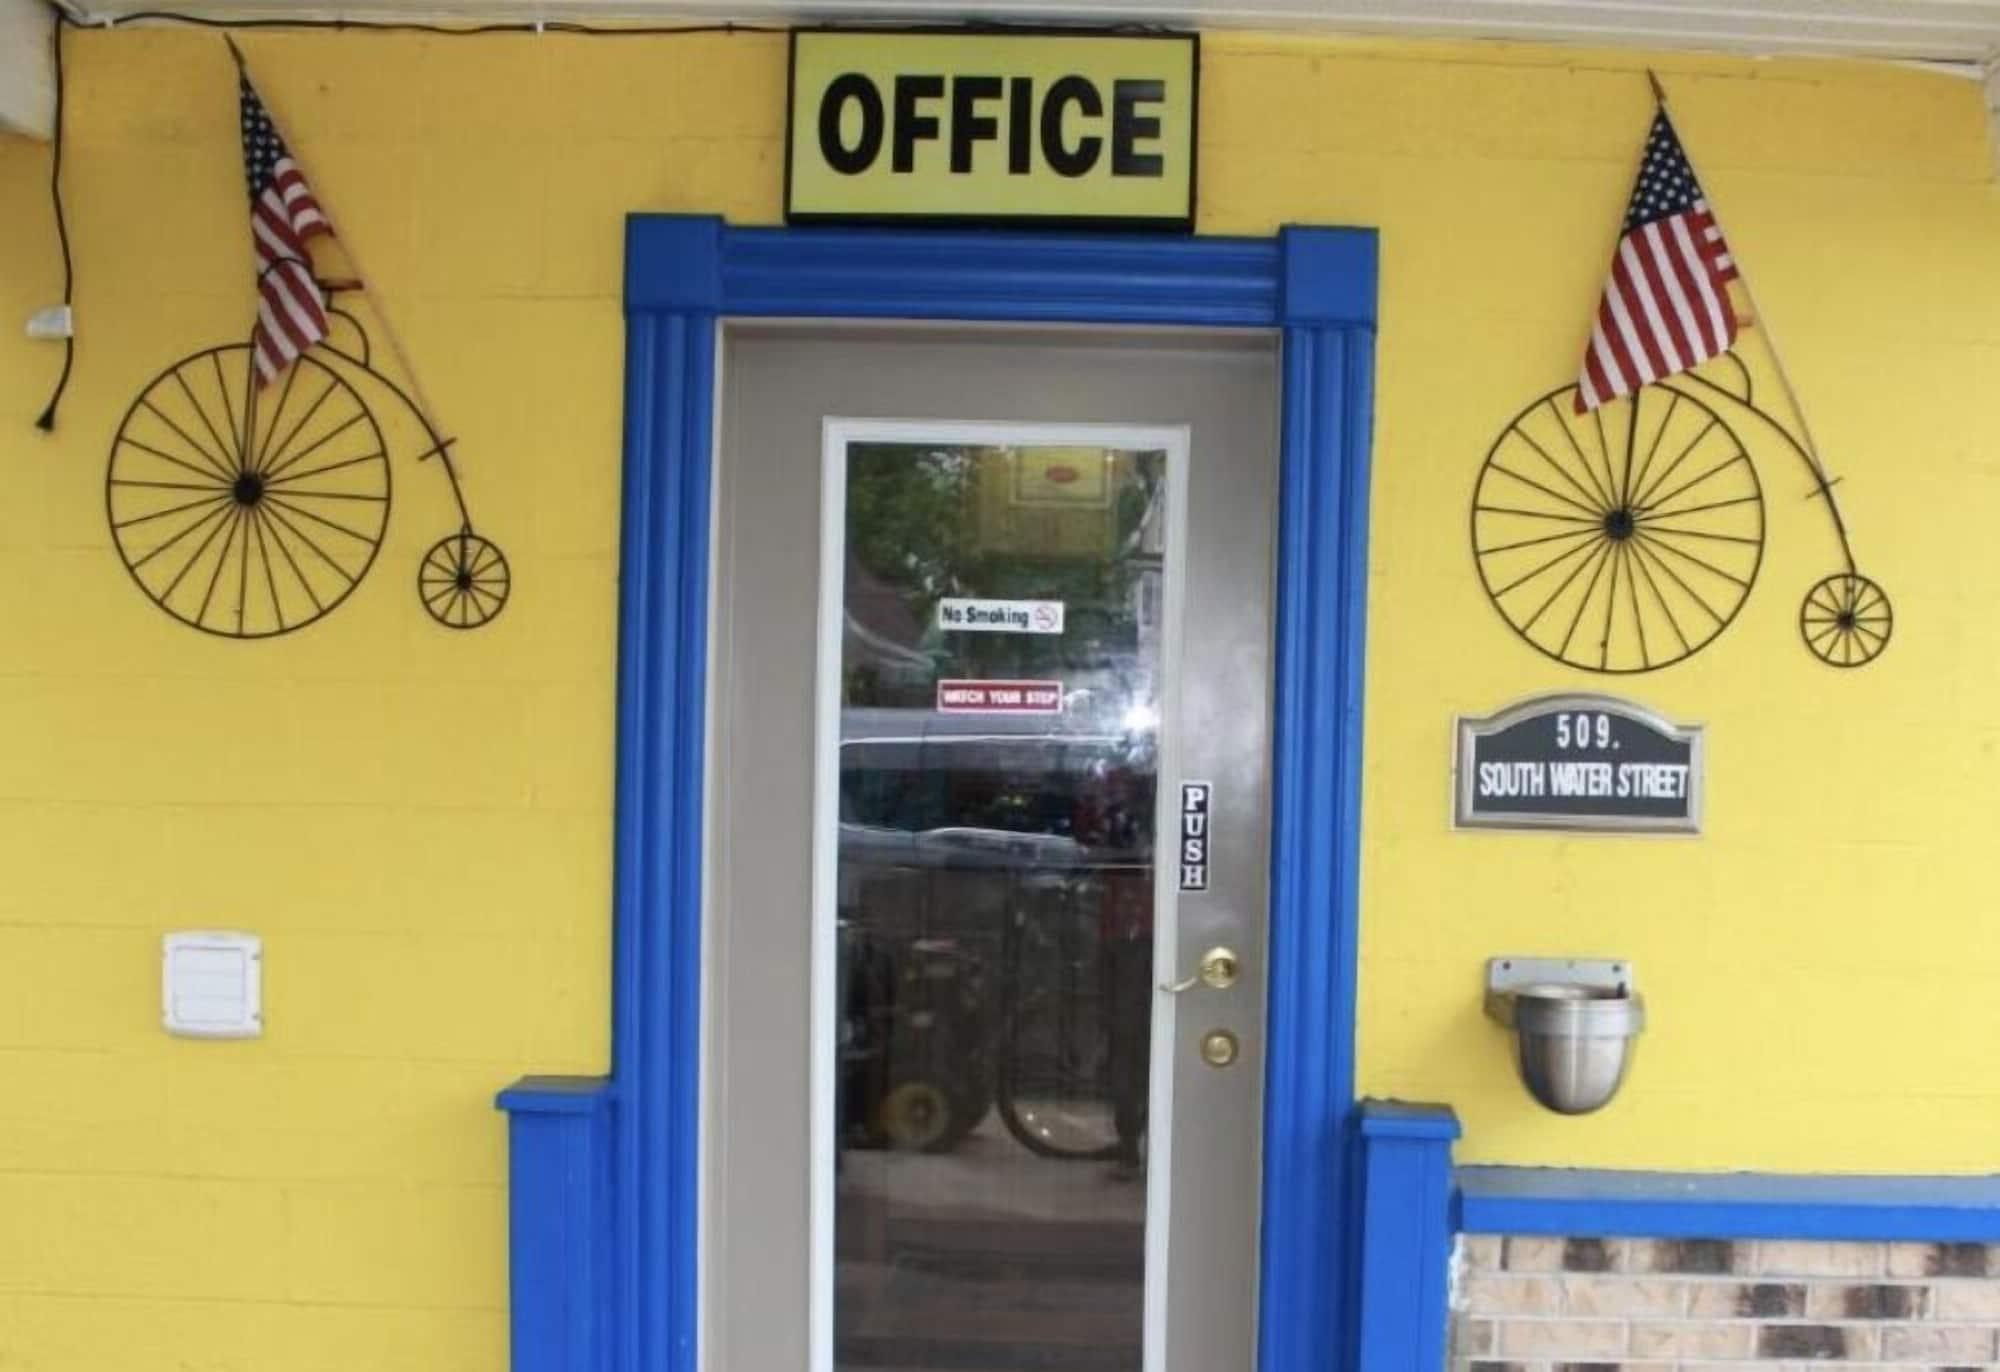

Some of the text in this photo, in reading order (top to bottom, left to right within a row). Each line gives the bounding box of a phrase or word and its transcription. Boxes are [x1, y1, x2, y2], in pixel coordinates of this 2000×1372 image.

[818, 72, 1166, 178] OFFICE
[943, 606, 1029, 629] No Smoking
[1479, 761, 1689, 799] SOUTH WATER STREET
[1184, 787, 1206, 888] PUSH
